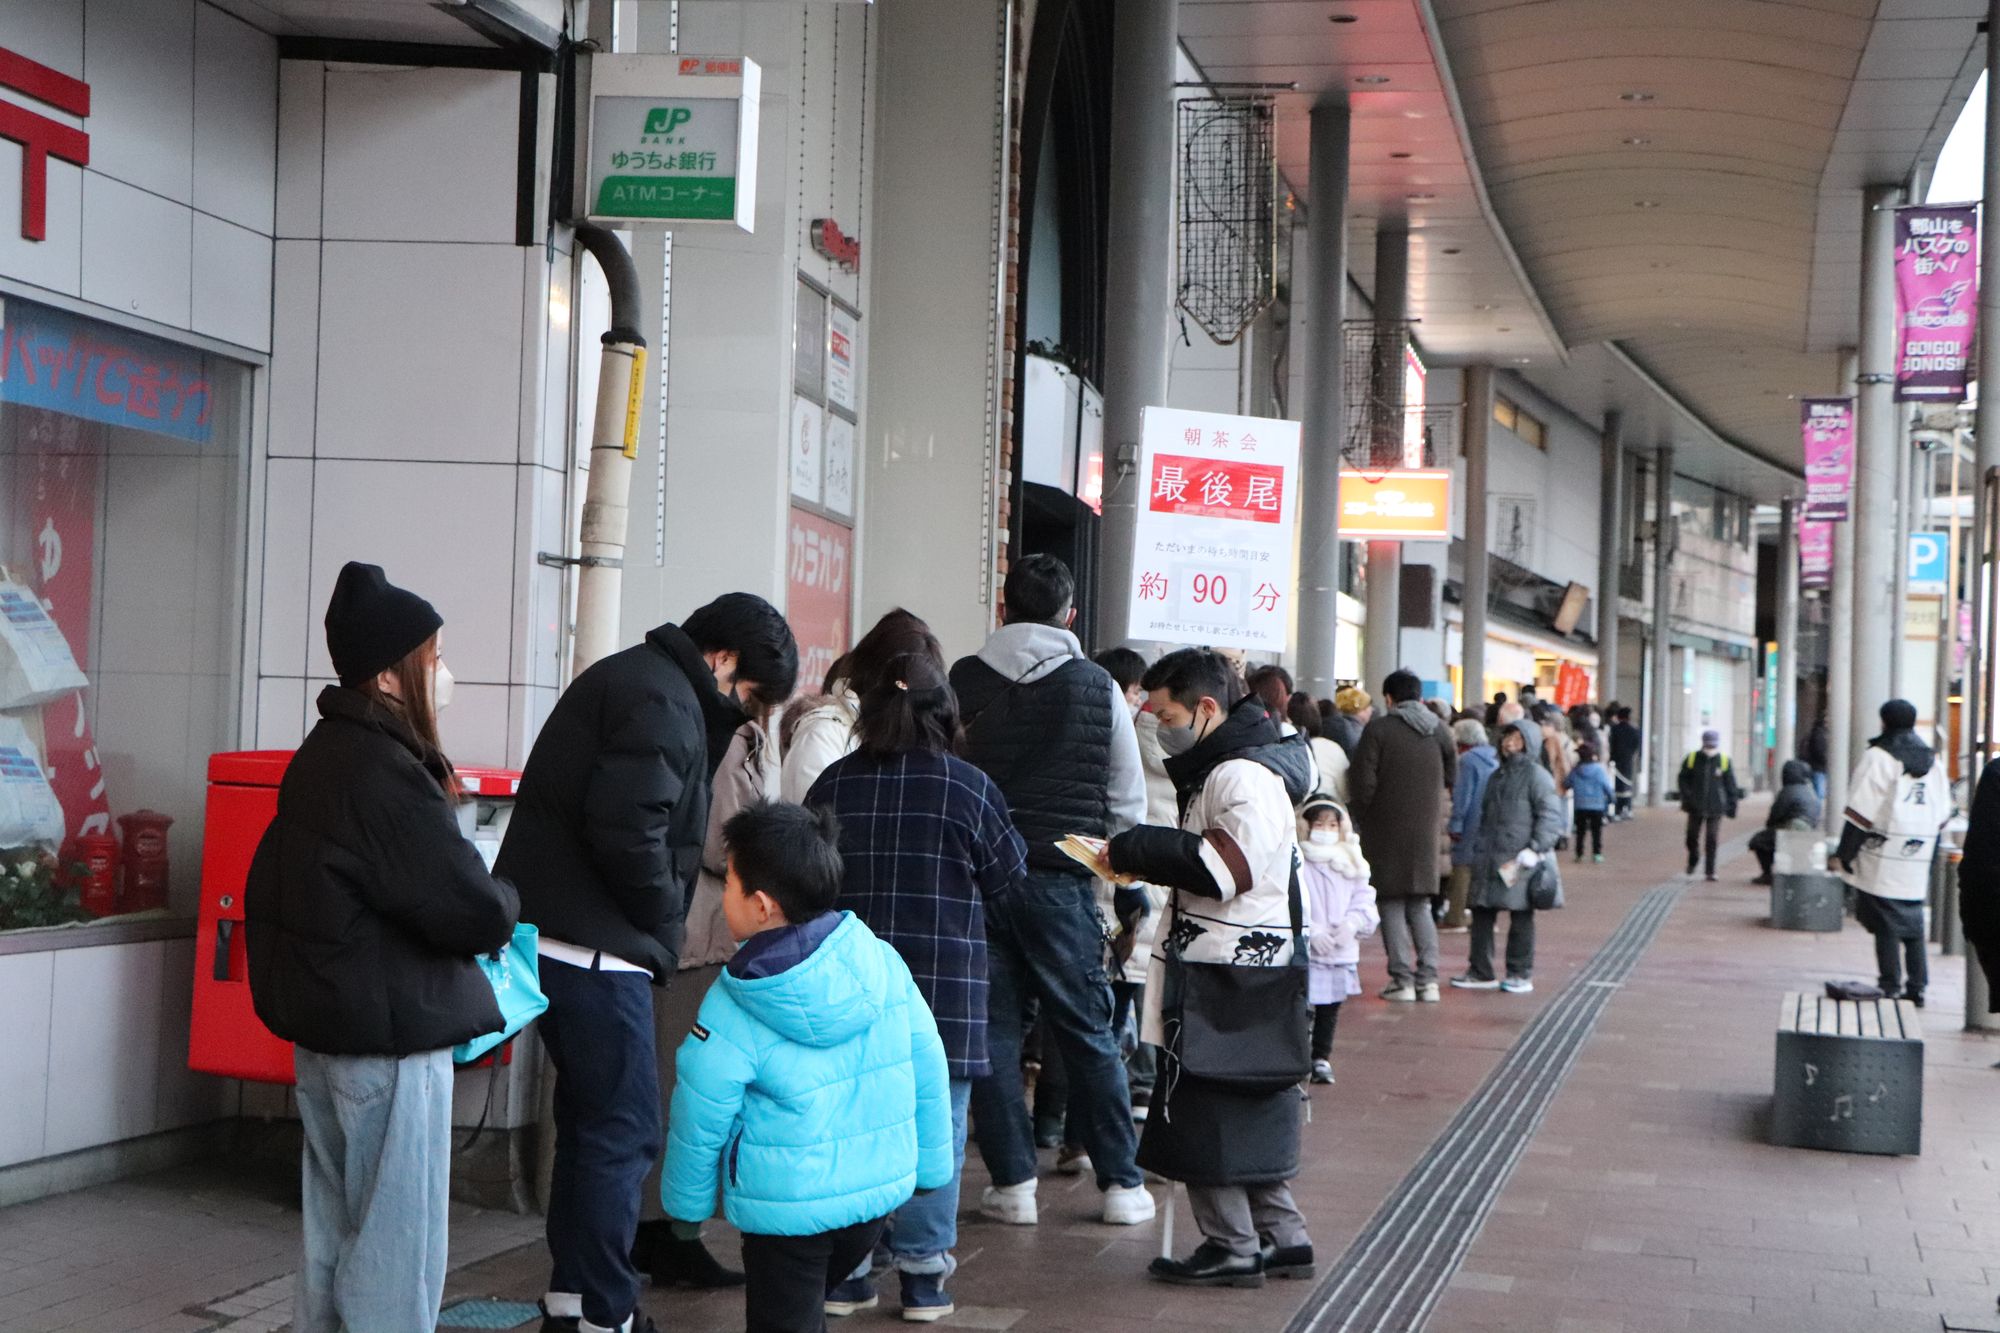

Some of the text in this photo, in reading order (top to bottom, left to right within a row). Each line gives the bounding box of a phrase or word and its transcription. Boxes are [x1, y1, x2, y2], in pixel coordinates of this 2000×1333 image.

[643, 107, 691, 134] JP
[640, 136, 687, 145] BANK
[611, 151, 717, 171] ゆうちょ銀行
[612, 184, 724, 201] ATMコーナー
[1902, 236, 1970, 255] バスケの
[1184, 427, 1258, 452] 朝茶会
[1153, 464, 1278, 511] 最後尾
[791, 524, 845, 593] カラオケ
[1154, 541, 1270, 562] ただいまの待ち時間目安
[1909, 537, 1938, 577] P
[1138, 571, 1281, 612] 約 90 分
